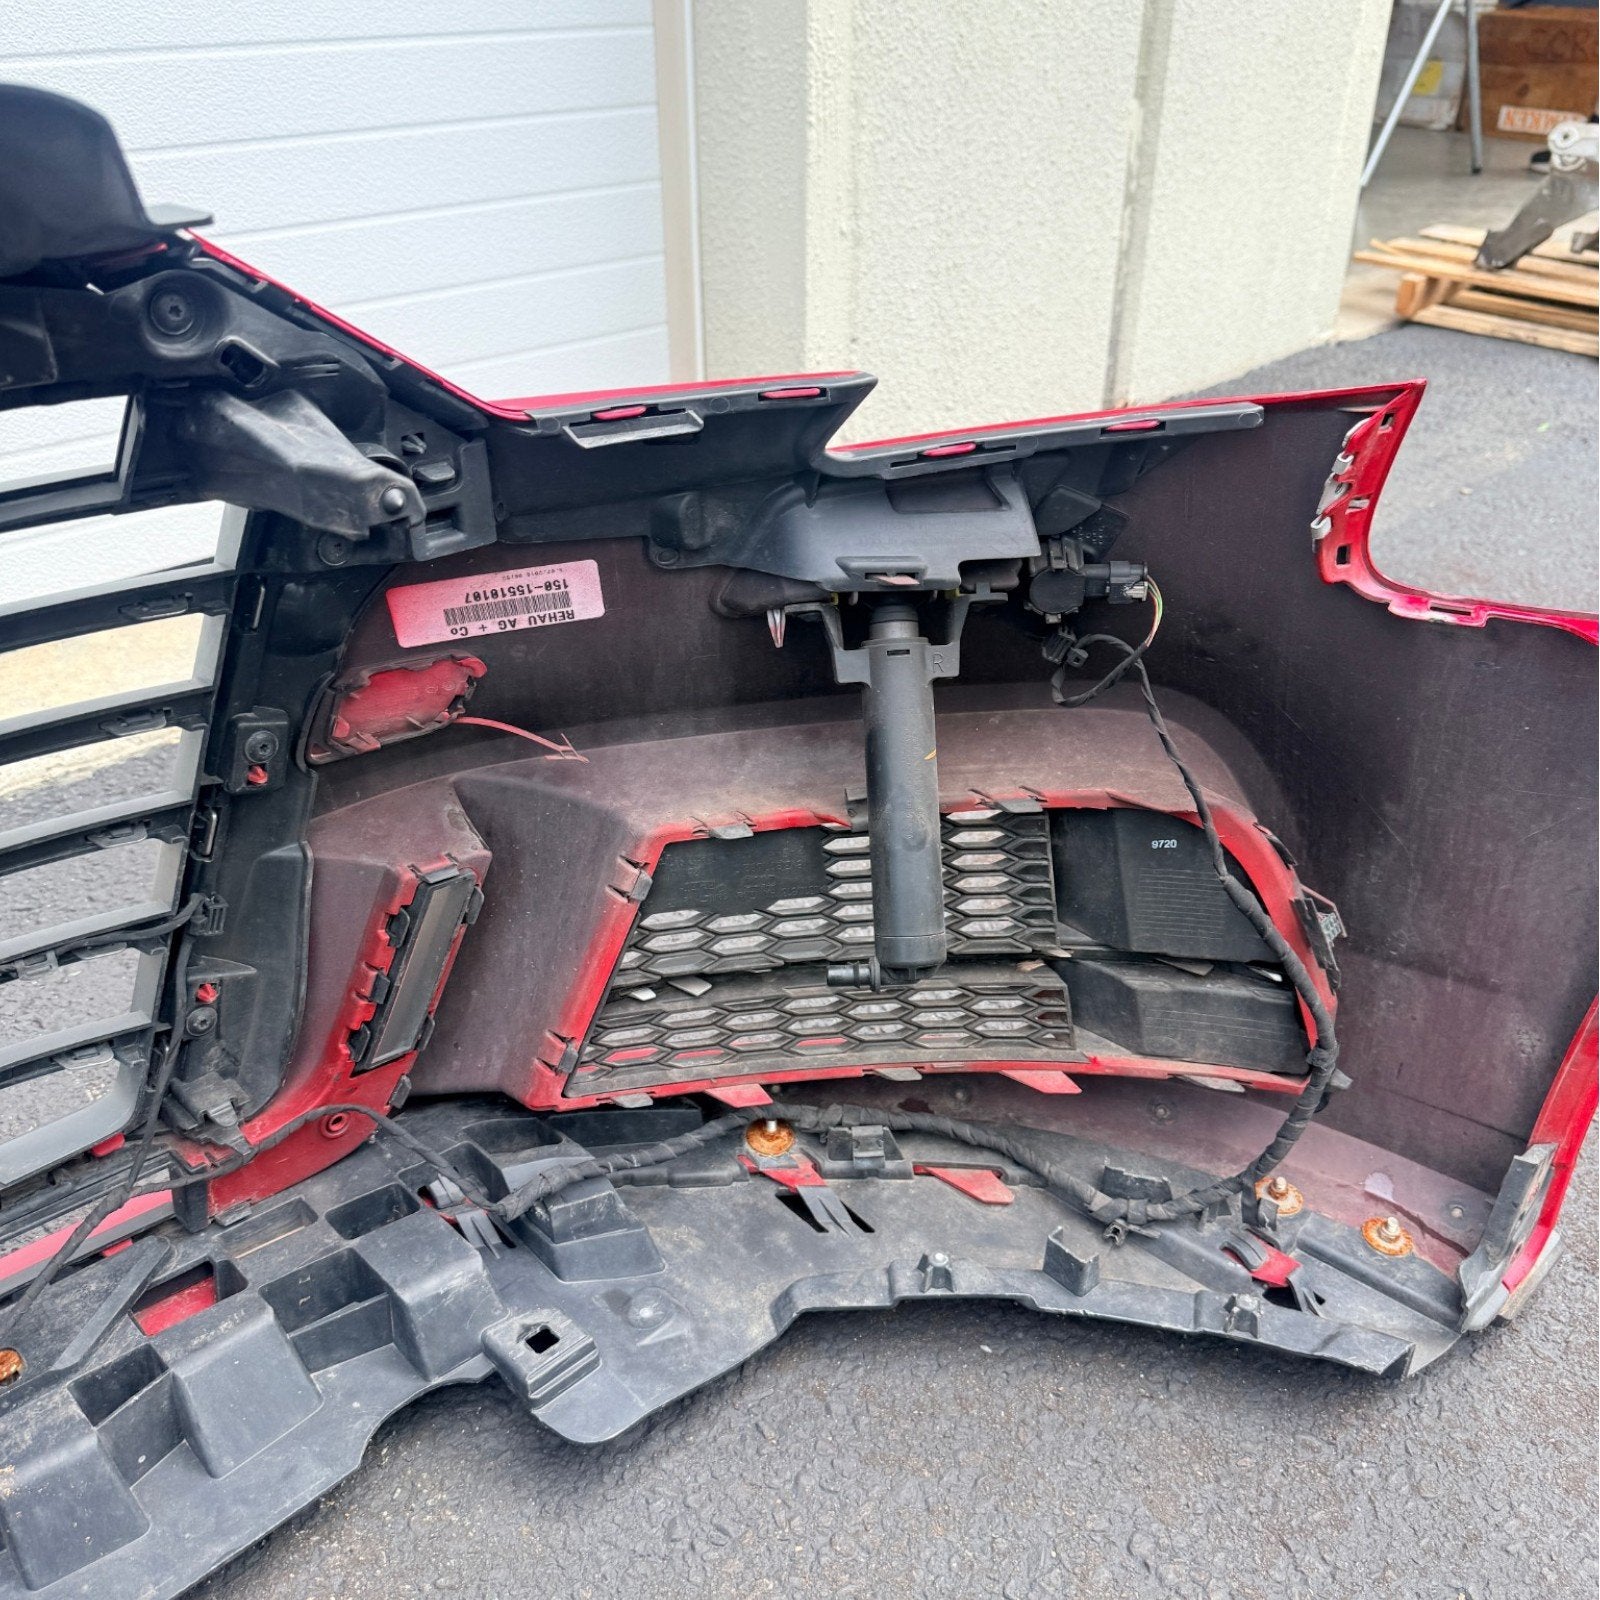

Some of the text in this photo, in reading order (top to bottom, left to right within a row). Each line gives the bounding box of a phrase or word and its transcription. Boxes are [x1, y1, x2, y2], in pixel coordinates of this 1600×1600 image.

[450, 609, 575, 636] REHAU AG + Co
[932, 652, 944, 673] R
[1151, 839, 1177, 849] 9720
